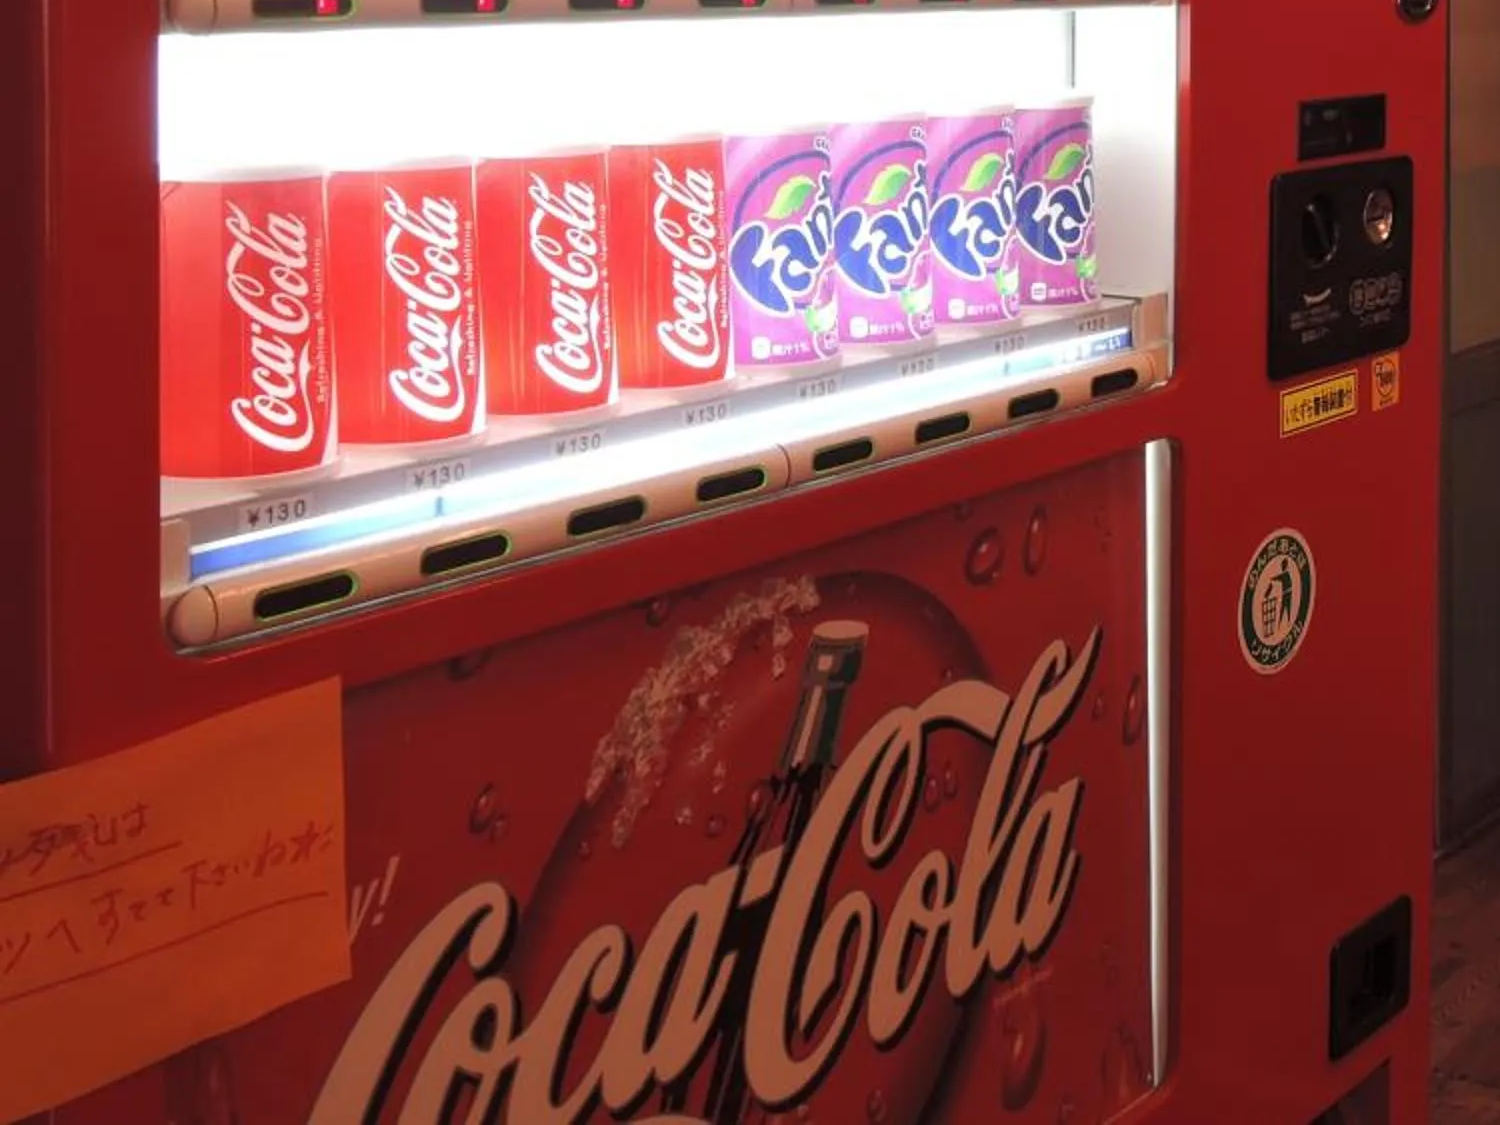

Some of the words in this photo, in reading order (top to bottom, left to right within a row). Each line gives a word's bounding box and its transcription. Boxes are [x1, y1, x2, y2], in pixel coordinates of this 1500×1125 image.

[384, 186, 465, 423] Coca-Cola
[528, 171, 604, 394] Coca-Cola
[652, 156, 723, 370] Coca-Cola
[225, 200, 315, 453] Coca-Cola
[555, 432, 602, 457] ¥130
[684, 403, 728, 425] ¥130
[247, 499, 307, 527] ¥130
[413, 461, 466, 489] ¥130
